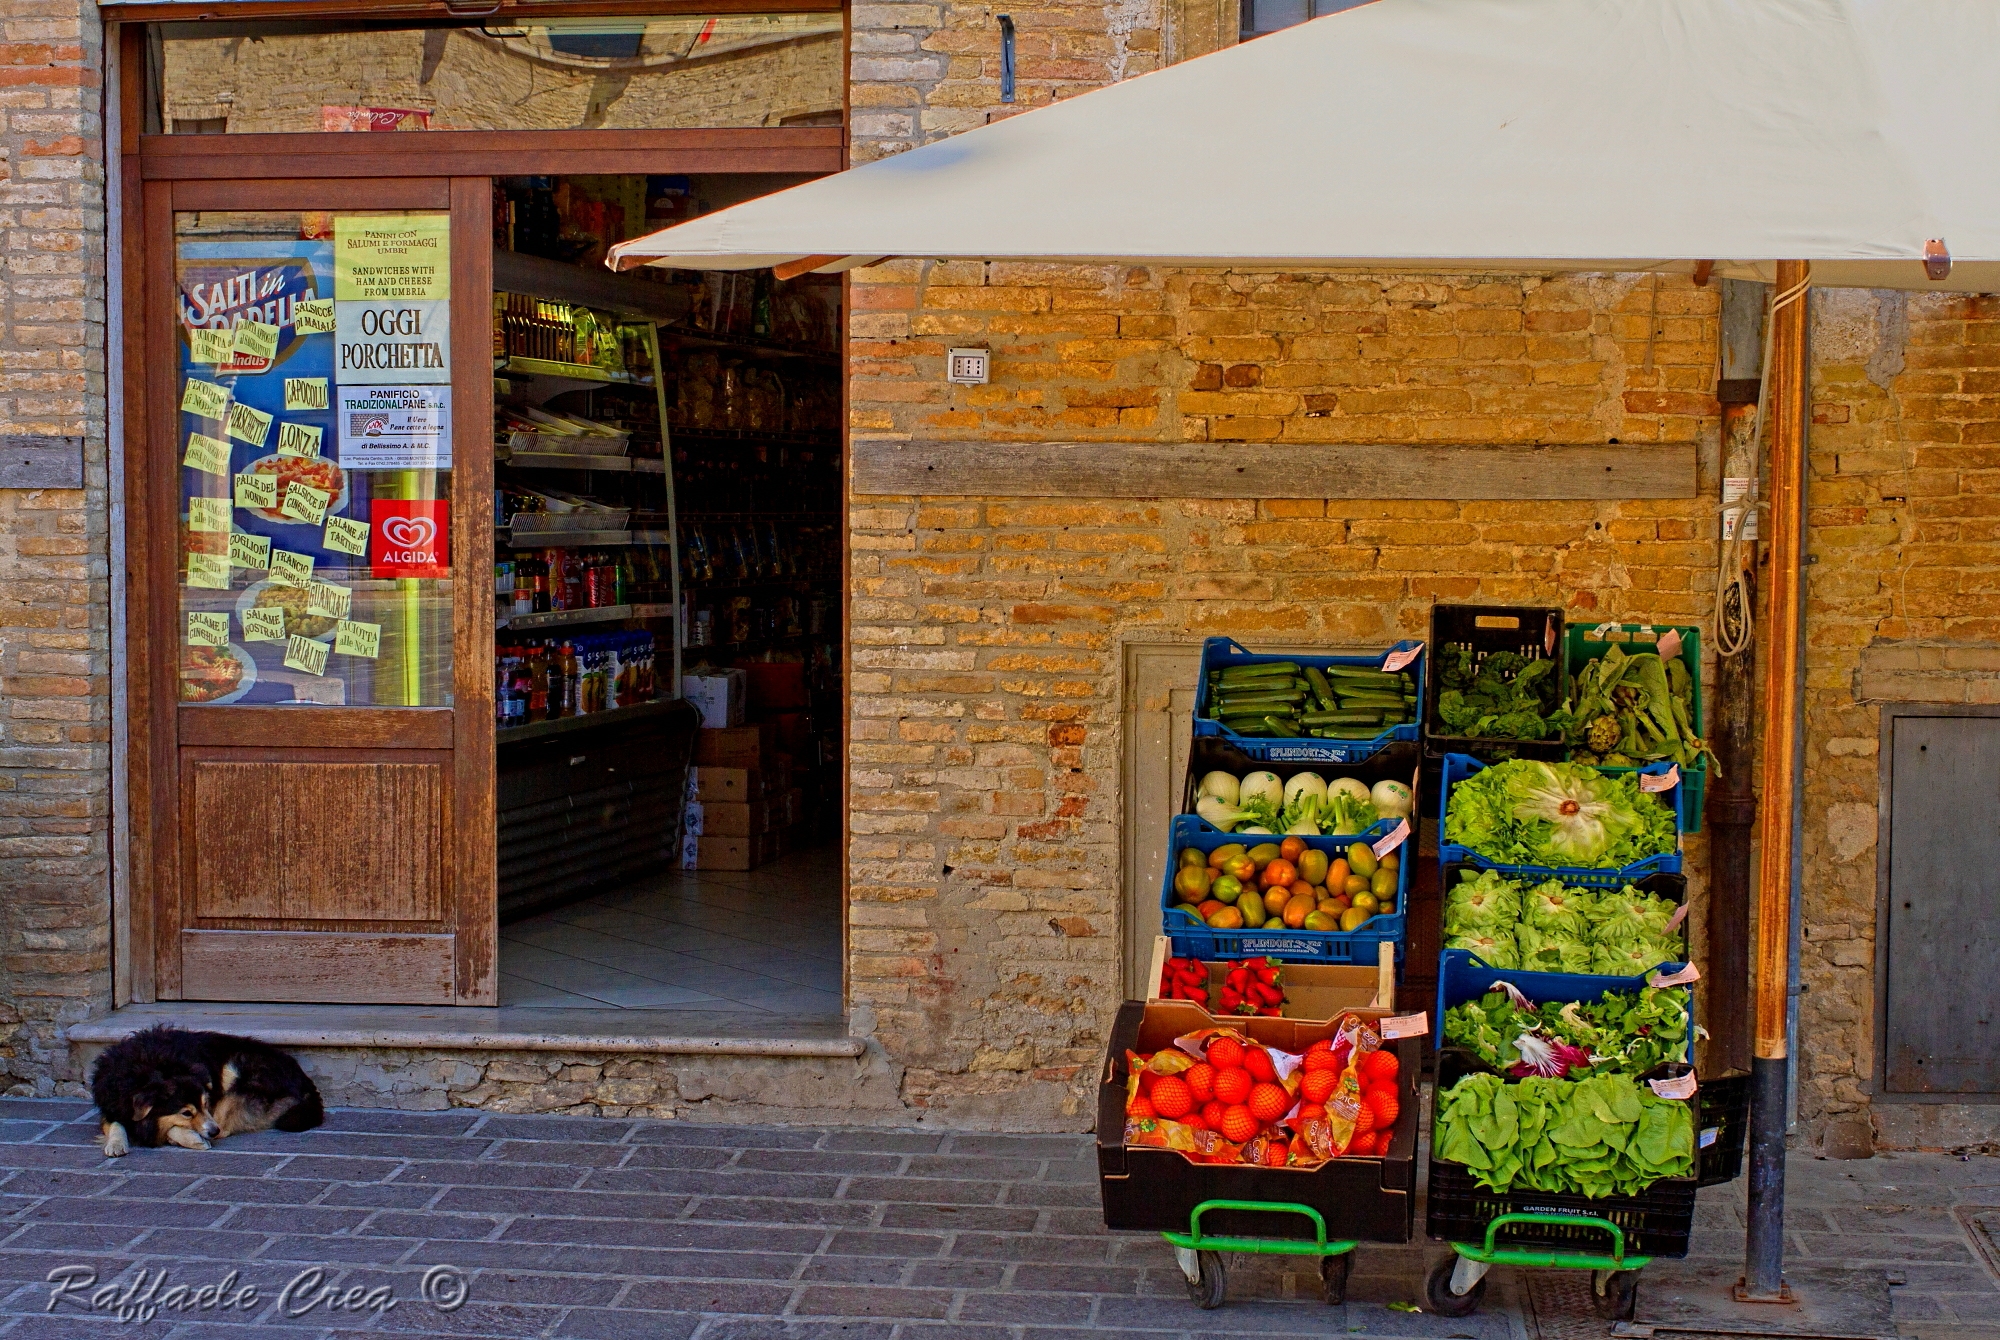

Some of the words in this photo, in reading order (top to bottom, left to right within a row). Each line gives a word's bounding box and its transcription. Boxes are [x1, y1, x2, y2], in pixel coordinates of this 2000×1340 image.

[347, 238, 380, 249] SALUMI
[390, 238, 437, 248] FORMAGGI
[365, 230, 396, 239] PANINI
[398, 230, 417, 239] CON
[352, 266, 410, 275] SANDWICHES
[411, 266, 435, 275] WITH
[356, 277, 375, 286] HAM
[378, 277, 397, 286] AND
[398, 277, 432, 285] CHEESE
[187, 271, 257, 326] SALTI
[261, 273, 286, 298] in
[364, 288, 389, 296] FROM
[391, 287, 426, 296] UMBRIA
[294, 303, 333, 318] SALSICCE
[296, 320, 303, 331] DI
[304, 317, 337, 332] MAIALE
[361, 309, 422, 336] OGGI
[194, 343, 231, 362] TARTUFO
[232, 353, 266, 366] indus
[341, 342, 445, 369] PORCHETTA
[286, 379, 329, 408] CAPOCOLLO
[370, 390, 420, 399] PANIFICIO
[345, 399, 426, 410] TRADIZIONALPANE
[279, 424, 320, 458] LONZA
[361, 442, 368, 450] di
[368, 442, 402, 450] Bellissimo
[236, 474, 260, 490] PALLE
[261, 482, 276, 493] DEL
[244, 489, 269, 508] NONNO
[287, 484, 318, 510] SALSICCE
[319, 499, 327, 510] DI
[286, 497, 321, 524] CINGHIALE
[327, 516, 357, 539] SALAME
[357, 530, 368, 541] AL
[229, 534, 268, 555] COGLIONI
[330, 531, 363, 555] TARTUFO
[231, 548, 240, 558] DI
[241, 551, 265, 570] MULO
[275, 551, 309, 575] TRANCIO
[382, 551, 438, 563] ALGIDA
[270, 566, 311, 589] CINGHIALE
[308, 582, 351, 618] GUANCIALE
[189, 612, 220, 632] SALAME
[221, 619, 230, 632] DI
[245, 609, 280, 626] SALAME
[189, 628, 228, 647] CINGHIALE
[244, 623, 285, 639] NOSTRALE
[337, 620, 378, 643] CACIOTTA
[339, 635, 354, 647] alle
[354, 642, 375, 657] NOCI
